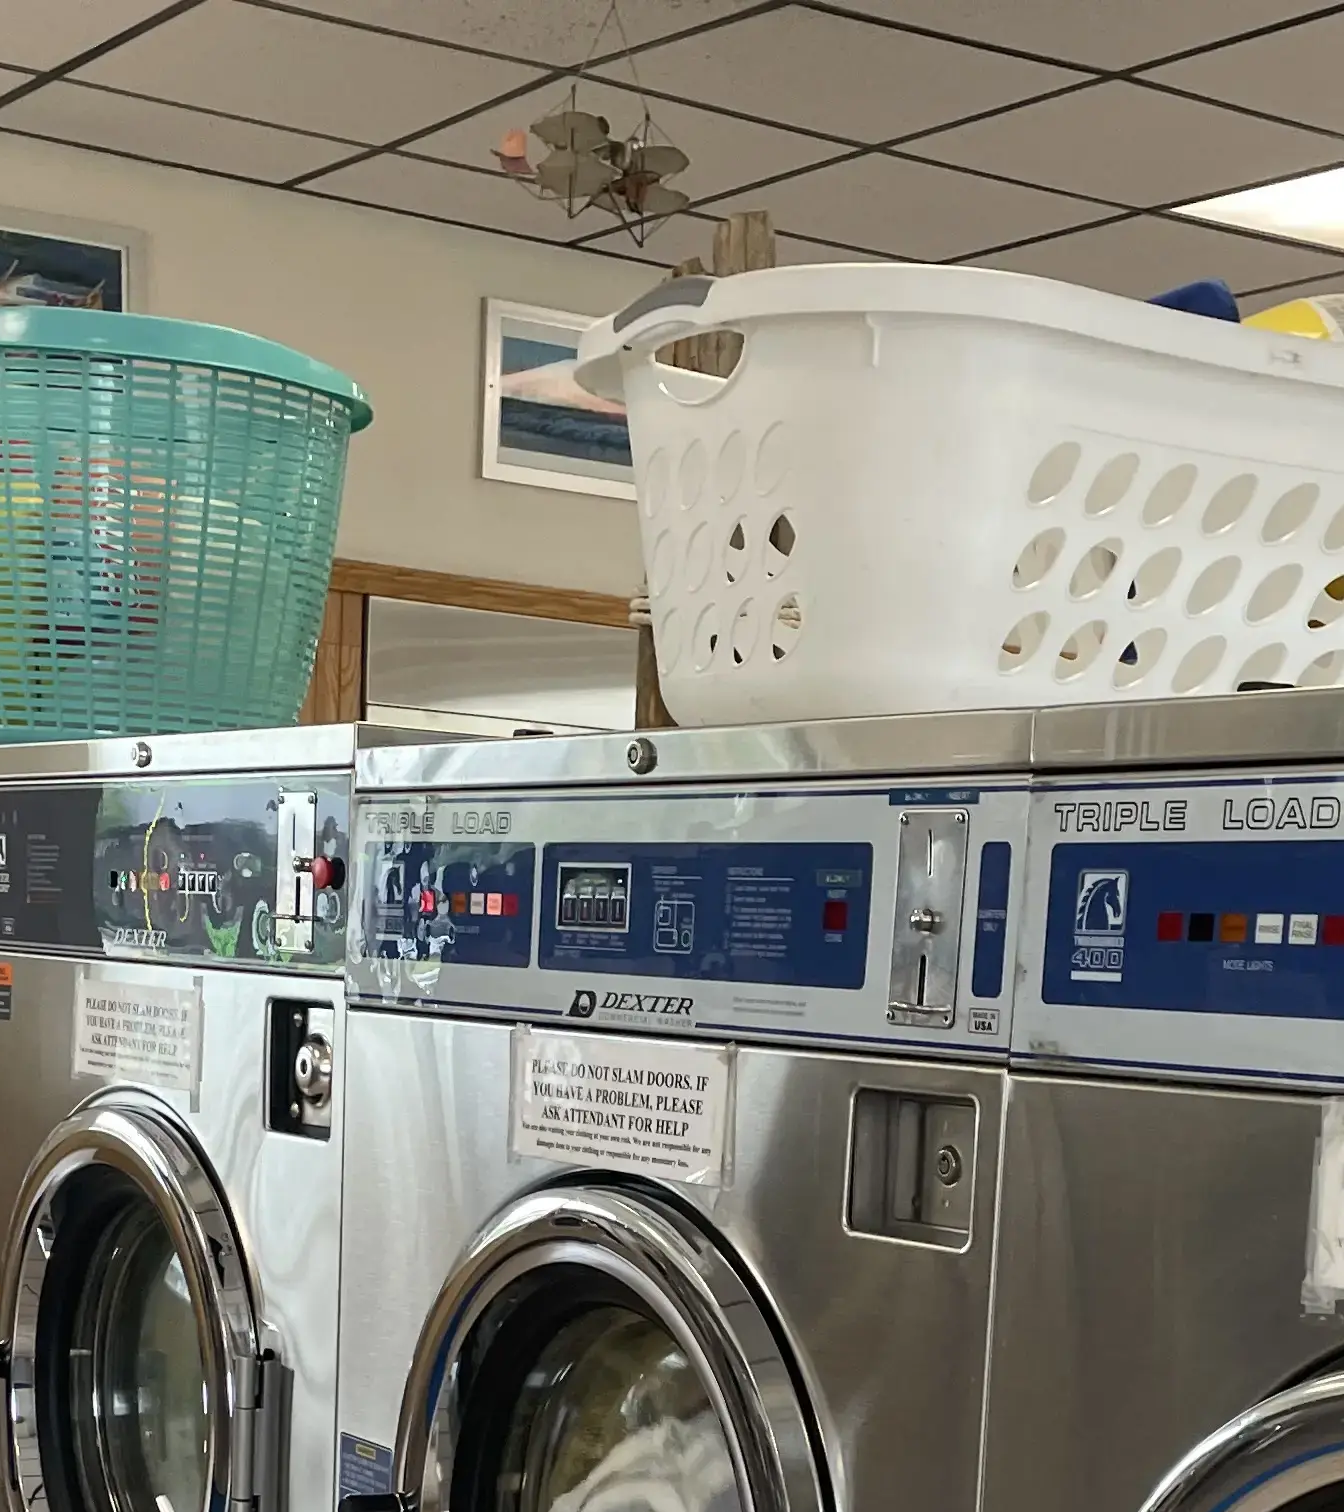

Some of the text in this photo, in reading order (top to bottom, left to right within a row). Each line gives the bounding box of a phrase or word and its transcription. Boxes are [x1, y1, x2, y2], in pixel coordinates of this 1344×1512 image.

[366, 811, 512, 835] TRIPLE LOAD
[1054, 796, 1342, 832] TRIPLE LOAD
[114, 927, 168, 948] DEXTER
[1071, 948, 1125, 969] 400
[599, 992, 694, 1016] DEXTER
[974, 1019, 993, 1032] USA
[532, 1058, 568, 1077] PLEASE
[570, 1063, 586, 1079] DO
[587, 1064, 610, 1082] NOT
[611, 1067, 644, 1086] SLAM
[696, 1075, 710, 1092] IF
[533, 1080, 553, 1098] YOU
[555, 1083, 584, 1101] HAVE
[586, 1087, 593, 1102] A
[655, 1095, 704, 1116] PLEASE
[541, 1104, 690, 1137] ASK ATTENDANT FOR HELP
